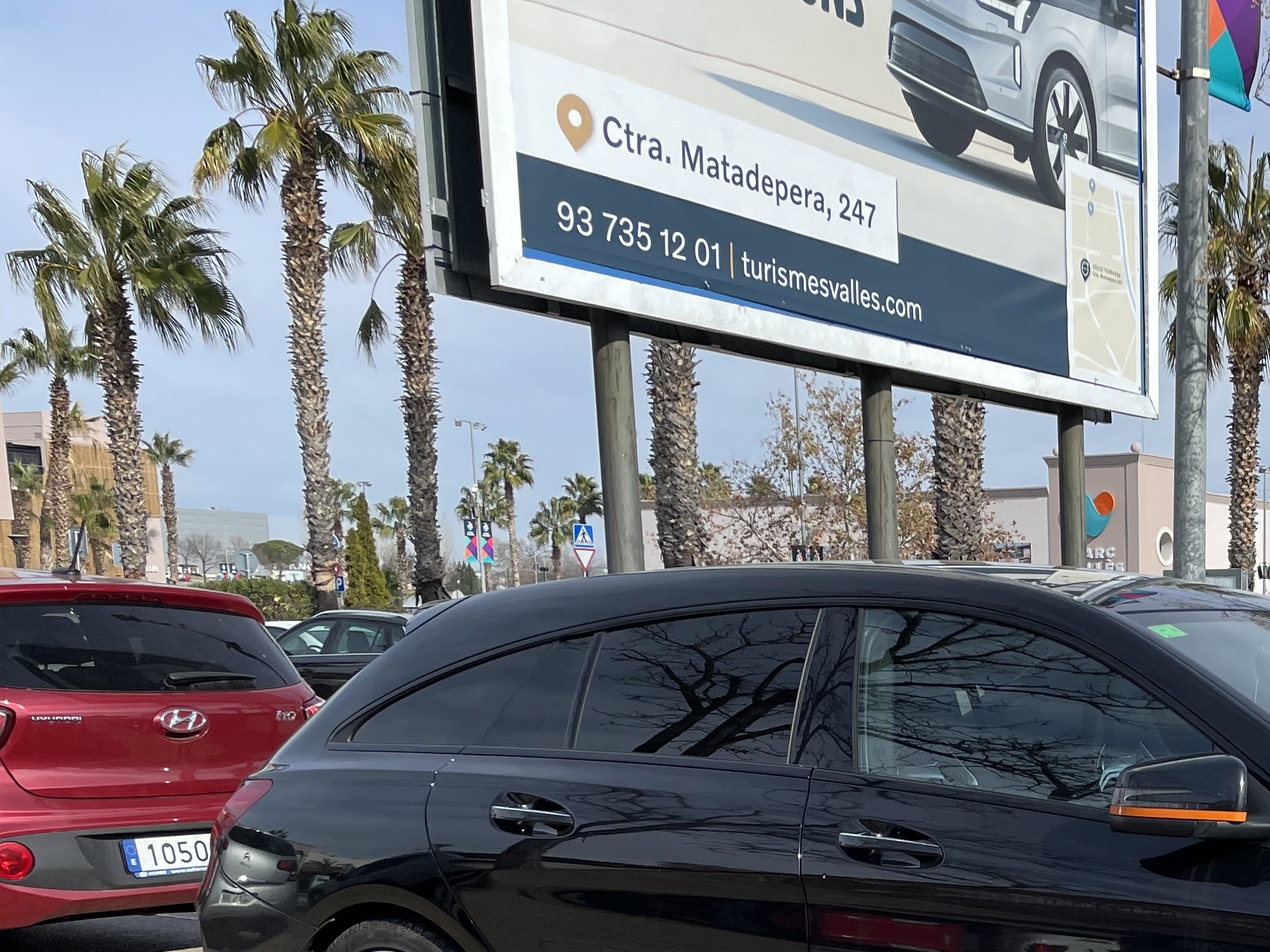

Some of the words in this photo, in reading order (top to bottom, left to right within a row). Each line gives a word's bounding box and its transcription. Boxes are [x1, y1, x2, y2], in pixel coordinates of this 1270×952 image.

[603, 116, 671, 164] Ctra.
[681, 140, 832, 221] Matadepera,
[839, 194, 876, 228] 247
[557, 201, 593, 237] 93
[602, 212, 651, 251] 735
[660, 229, 687, 261] 12
[695, 237, 720, 270] 01
[741, 251, 922, 322] turismesvalles.com
[1086, 547, 1116, 559] ARC
[145, 564, 159, 572] LUB
[147, 840, 208, 867] 1050
